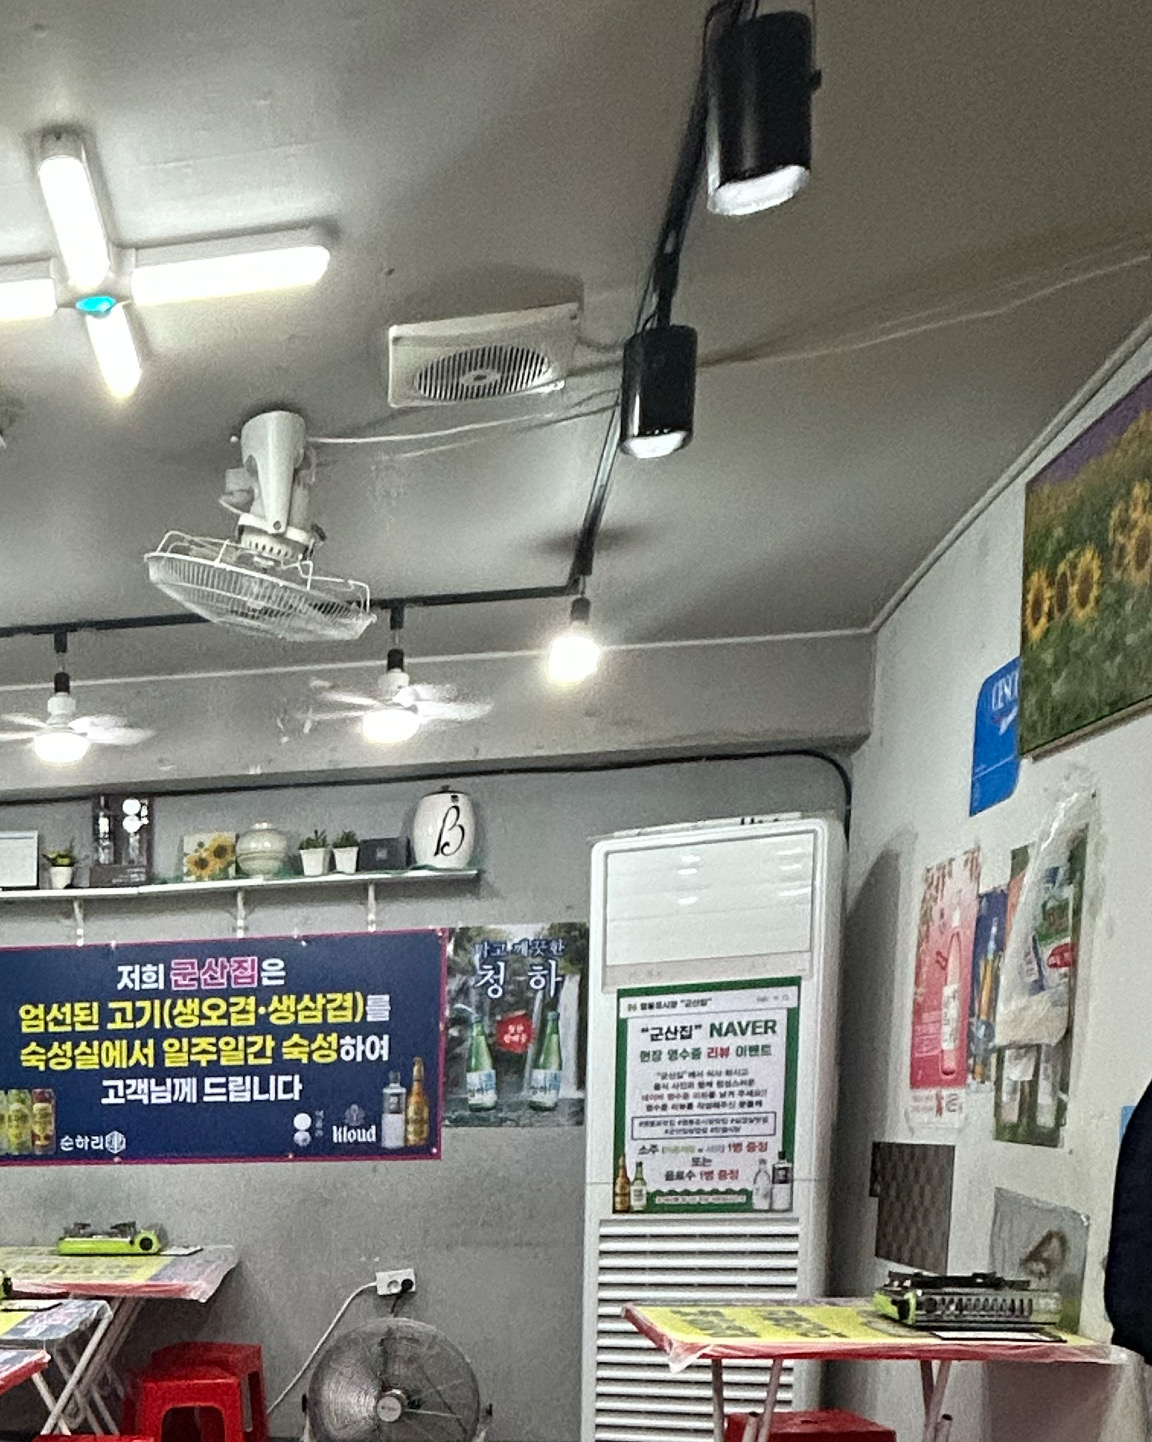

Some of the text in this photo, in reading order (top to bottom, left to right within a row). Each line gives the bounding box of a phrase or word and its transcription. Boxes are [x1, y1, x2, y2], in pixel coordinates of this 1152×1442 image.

[117, 956, 286, 990] 저희 군산집은
[19, 1001, 99, 1033] 엄선된
[709, 1019, 777, 1038] NAVER
[20, 1032, 390, 1071] 숙성실에서 일주일간 숙성하여
[707, 1046, 730, 1059] 리뷰
[736, 1044, 772, 1057] 이벤트
[101, 1074, 303, 1104] 고객님께 드립니다
[60, 1135, 104, 1151] 순하리
[332, 1125, 377, 1143] Kloud
